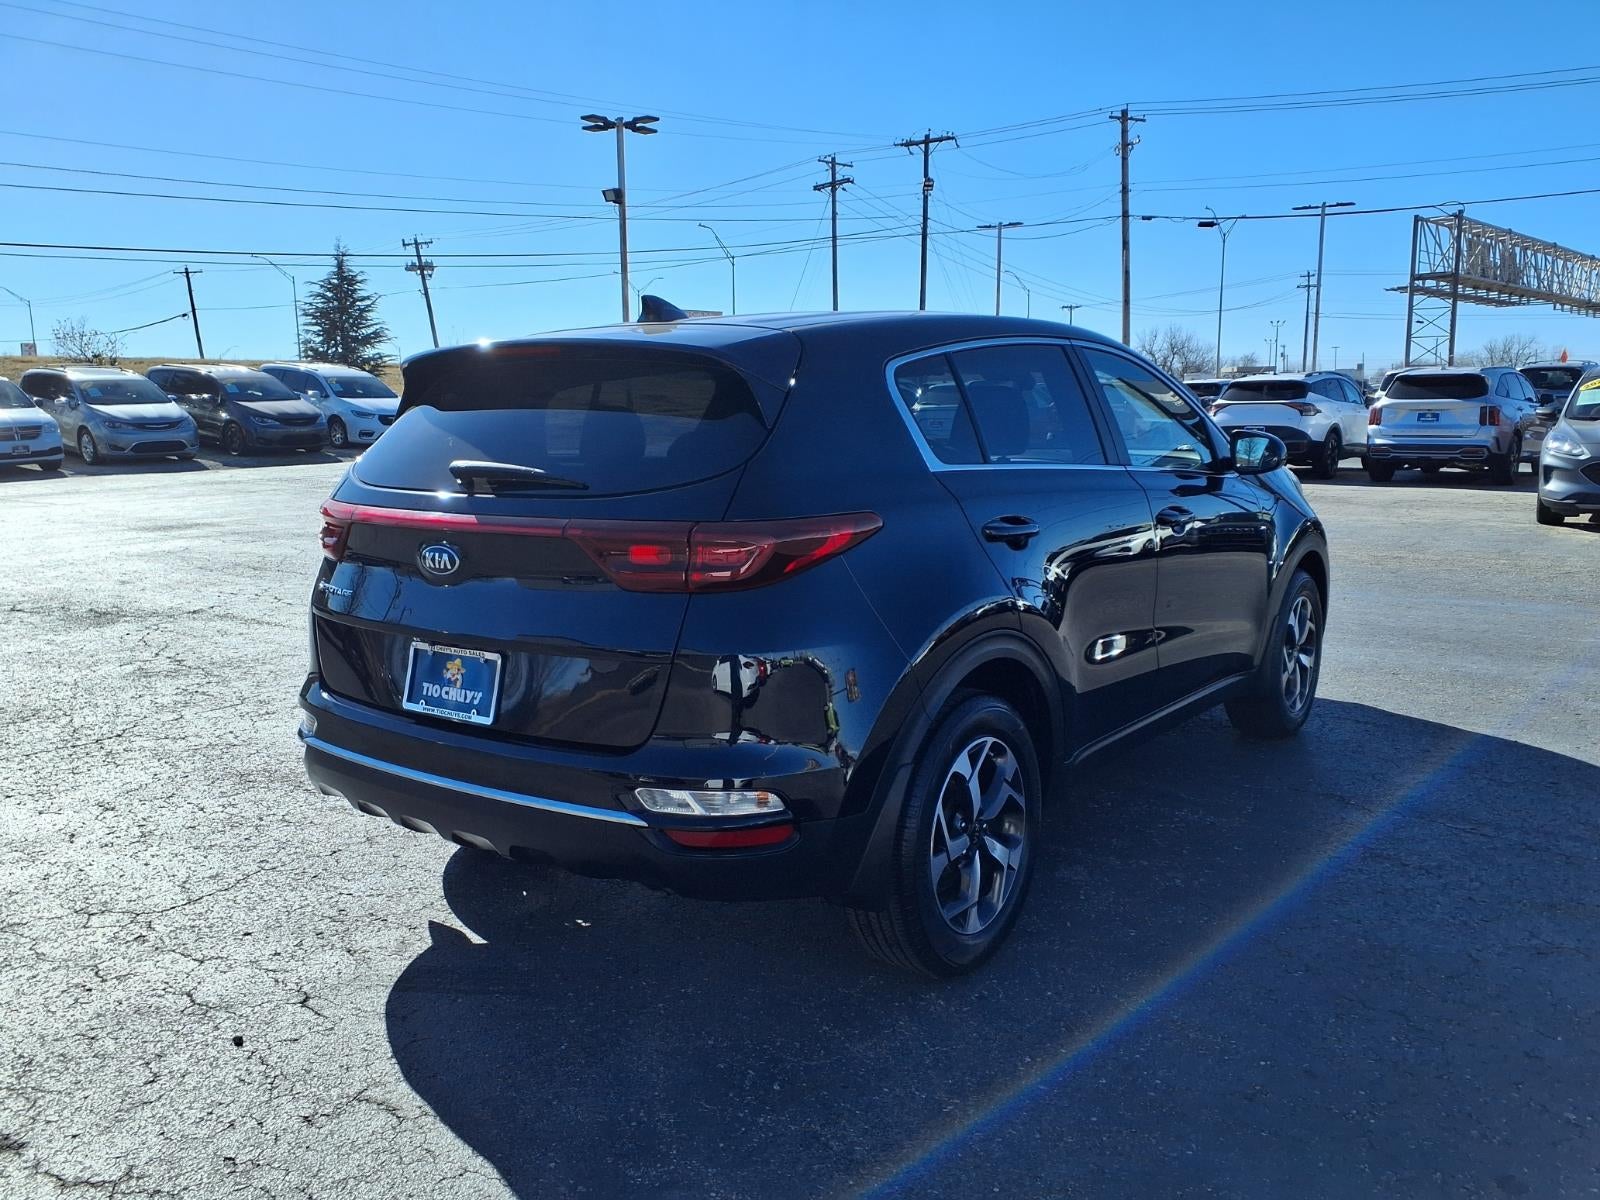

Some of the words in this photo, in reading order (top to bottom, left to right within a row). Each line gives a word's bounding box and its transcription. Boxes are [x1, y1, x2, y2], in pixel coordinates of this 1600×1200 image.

[425, 551, 451, 569] KIA
[453, 648, 468, 656] AUTO
[422, 682, 441, 698] TIO
[441, 686, 483, 705] CHUY'S
